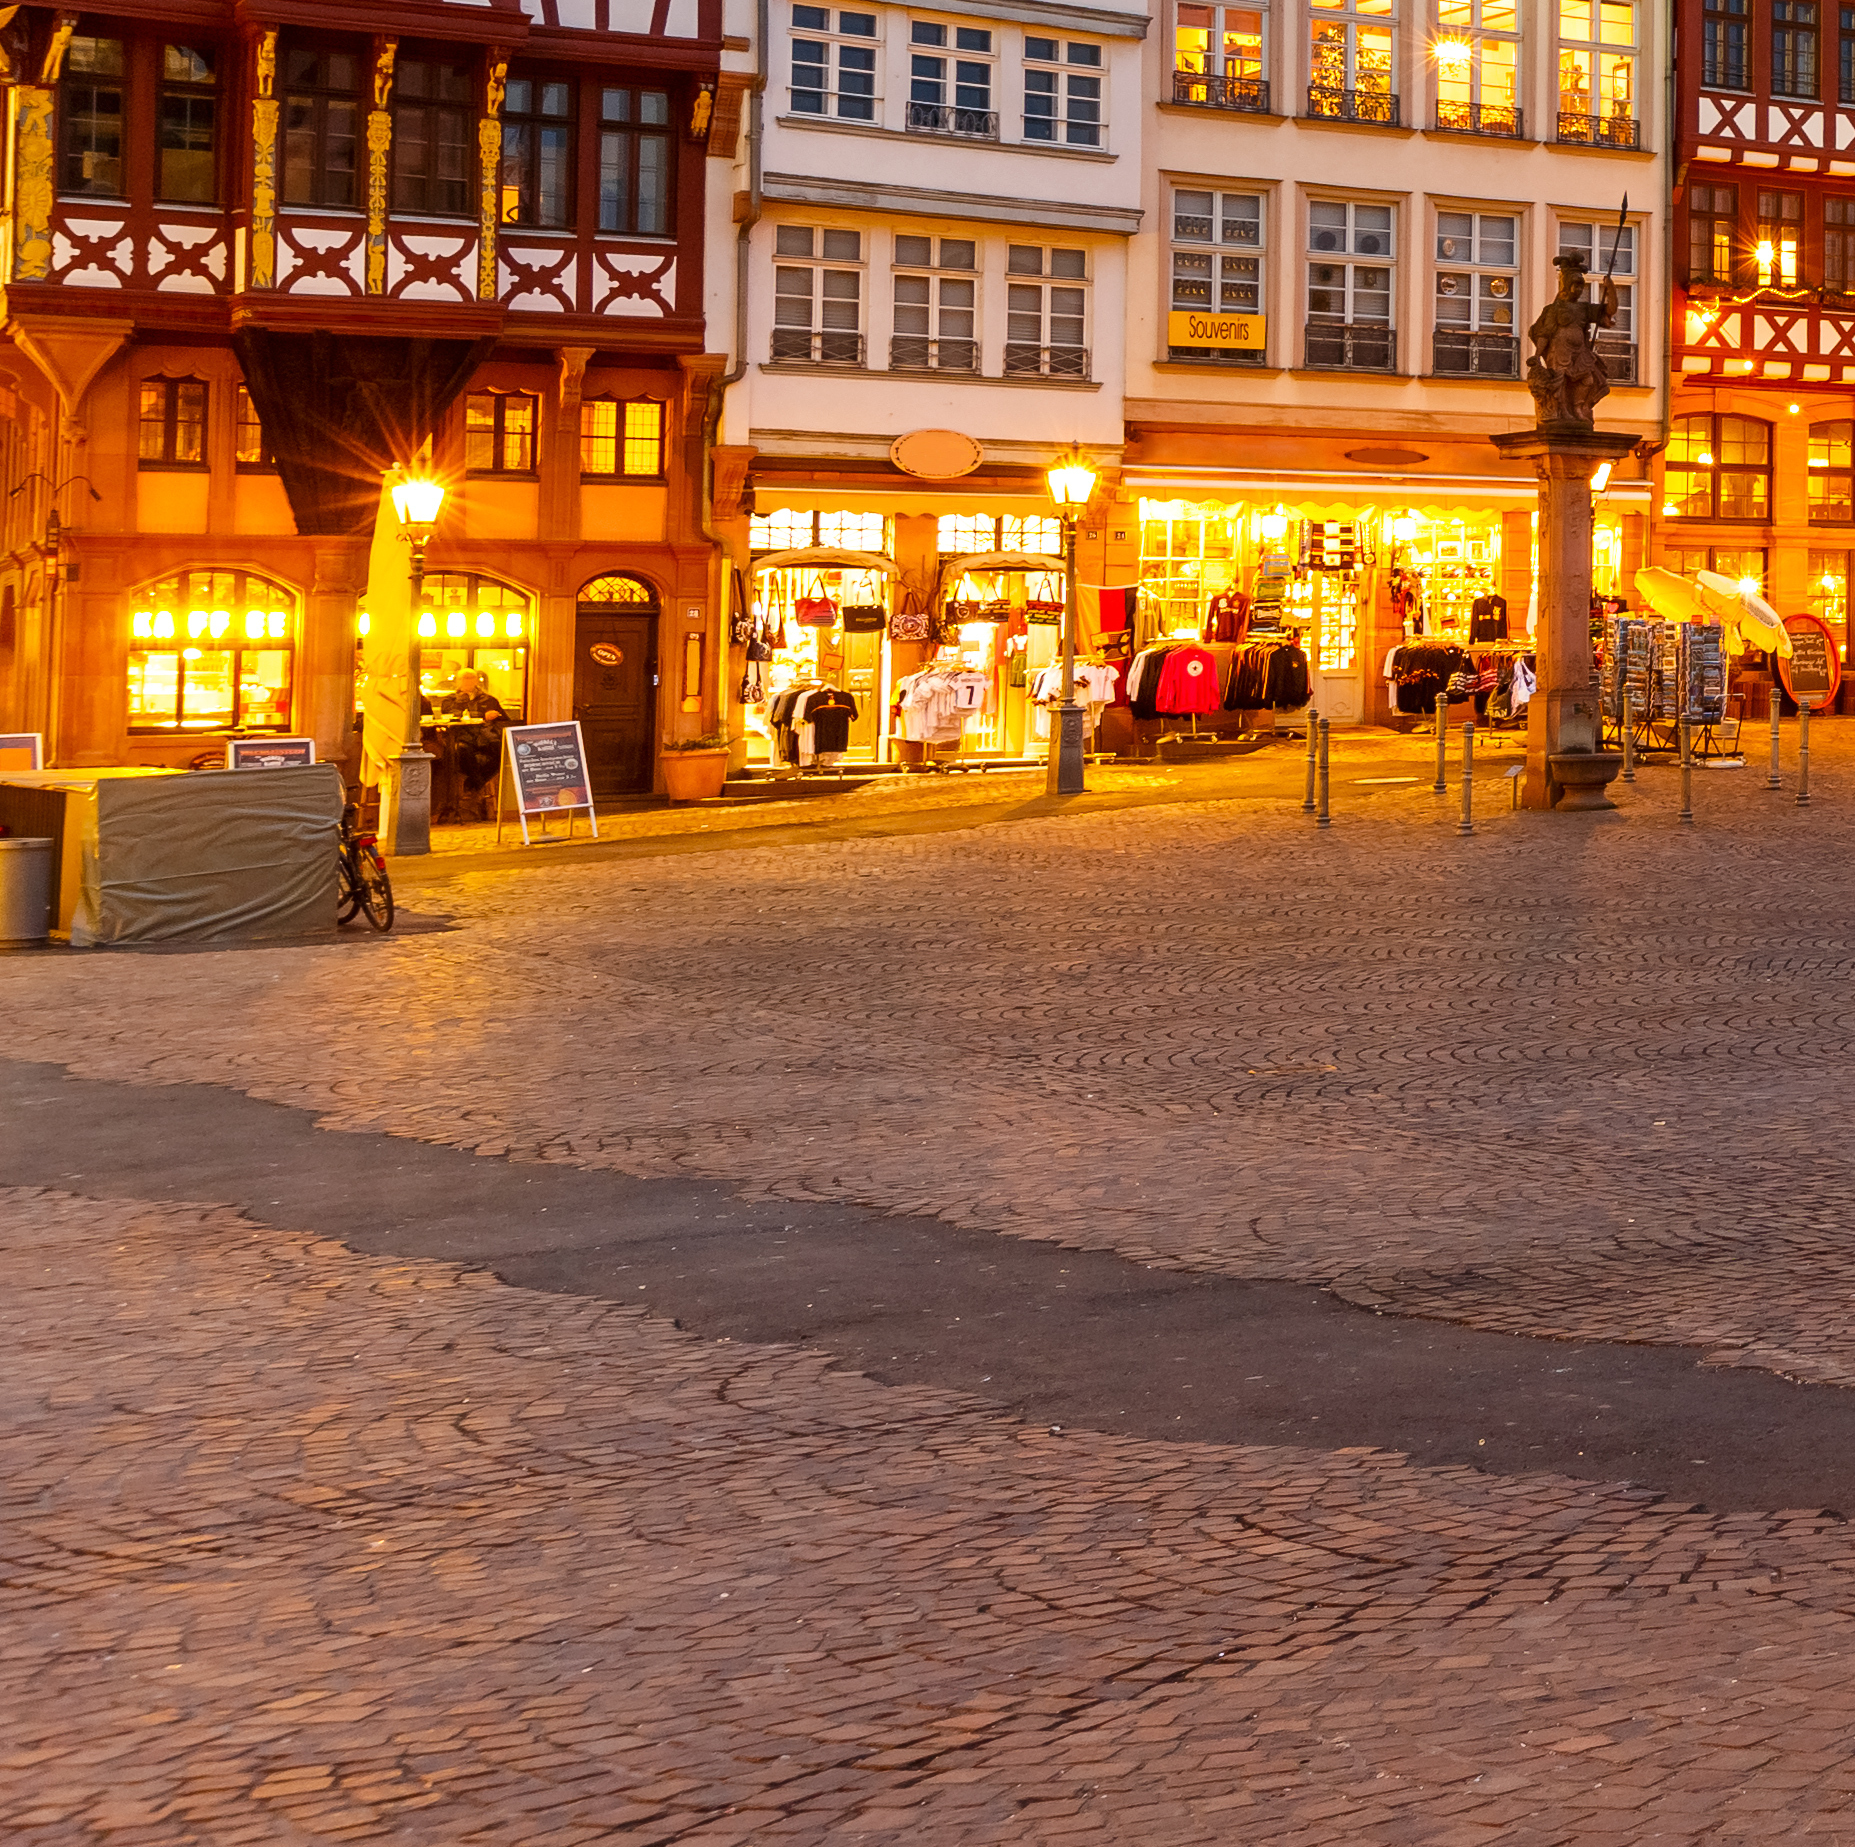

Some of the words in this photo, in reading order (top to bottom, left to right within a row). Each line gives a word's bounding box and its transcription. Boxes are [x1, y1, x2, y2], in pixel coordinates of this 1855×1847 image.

[1189, 315, 1249, 340] Souvenirs
[133, 610, 286, 639] KAFFEE
[966, 685, 975, 705] 7
